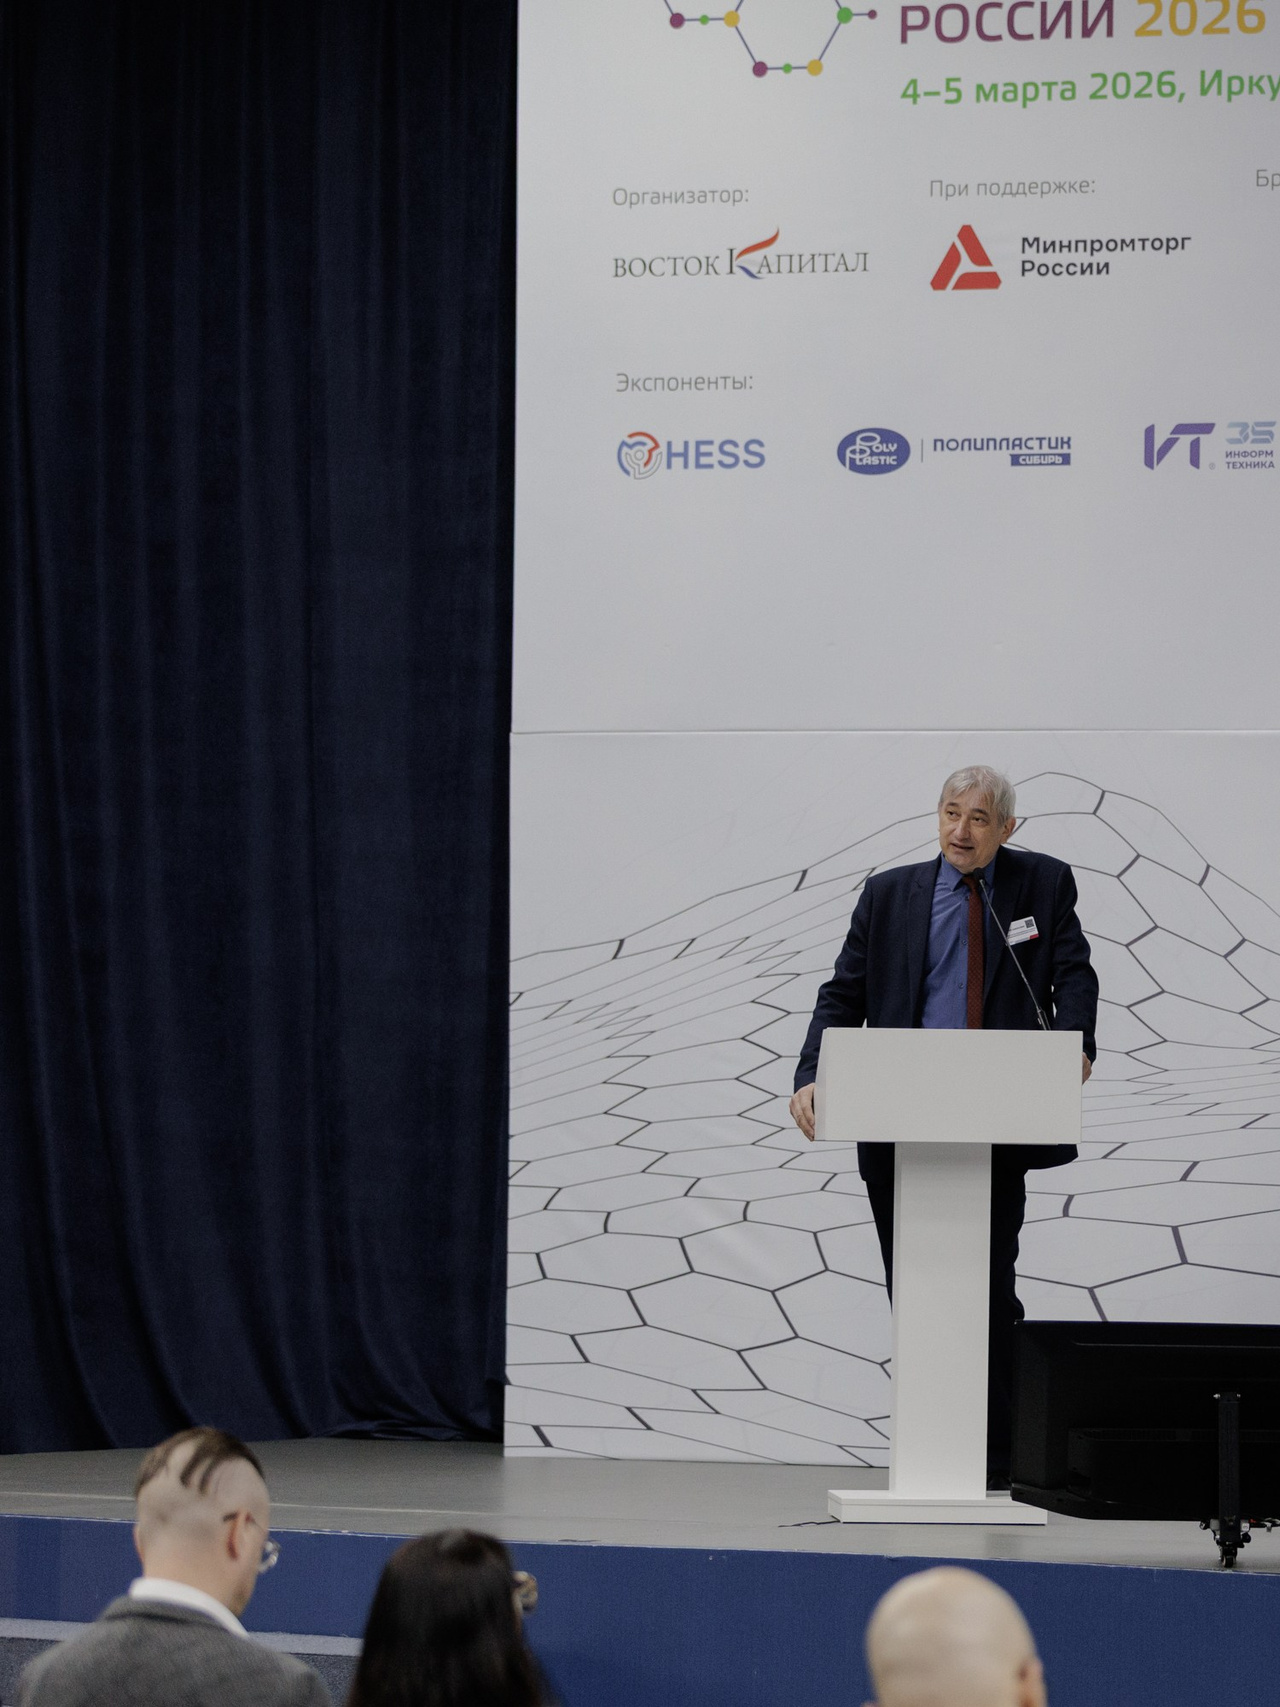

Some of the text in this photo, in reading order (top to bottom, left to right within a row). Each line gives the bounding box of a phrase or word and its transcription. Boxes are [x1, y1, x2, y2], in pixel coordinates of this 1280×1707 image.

[900, 0, 1267, 45] РОССИИ 2026
[975, 79, 1077, 110] марта
[1088, 69, 1186, 104] 2026,
[611, 187, 750, 210] Организатор:
[929, 179, 1096, 201] При поддержке:
[1021, 236, 1192, 257] Минпромторг
[613, 255, 720, 278] ВОСТОК
[1020, 259, 1110, 278] России
[615, 372, 754, 393] Экспоненты:
[665, 438, 766, 471] HESS
[933, 436, 1072, 452] ПОЛИПЛАСТИК
[1224, 449, 1275, 459] ИНФОРМ
[1018, 455, 1063, 465] СИБИРЬ
[1225, 460, 1276, 470] ТЕХНИКА
